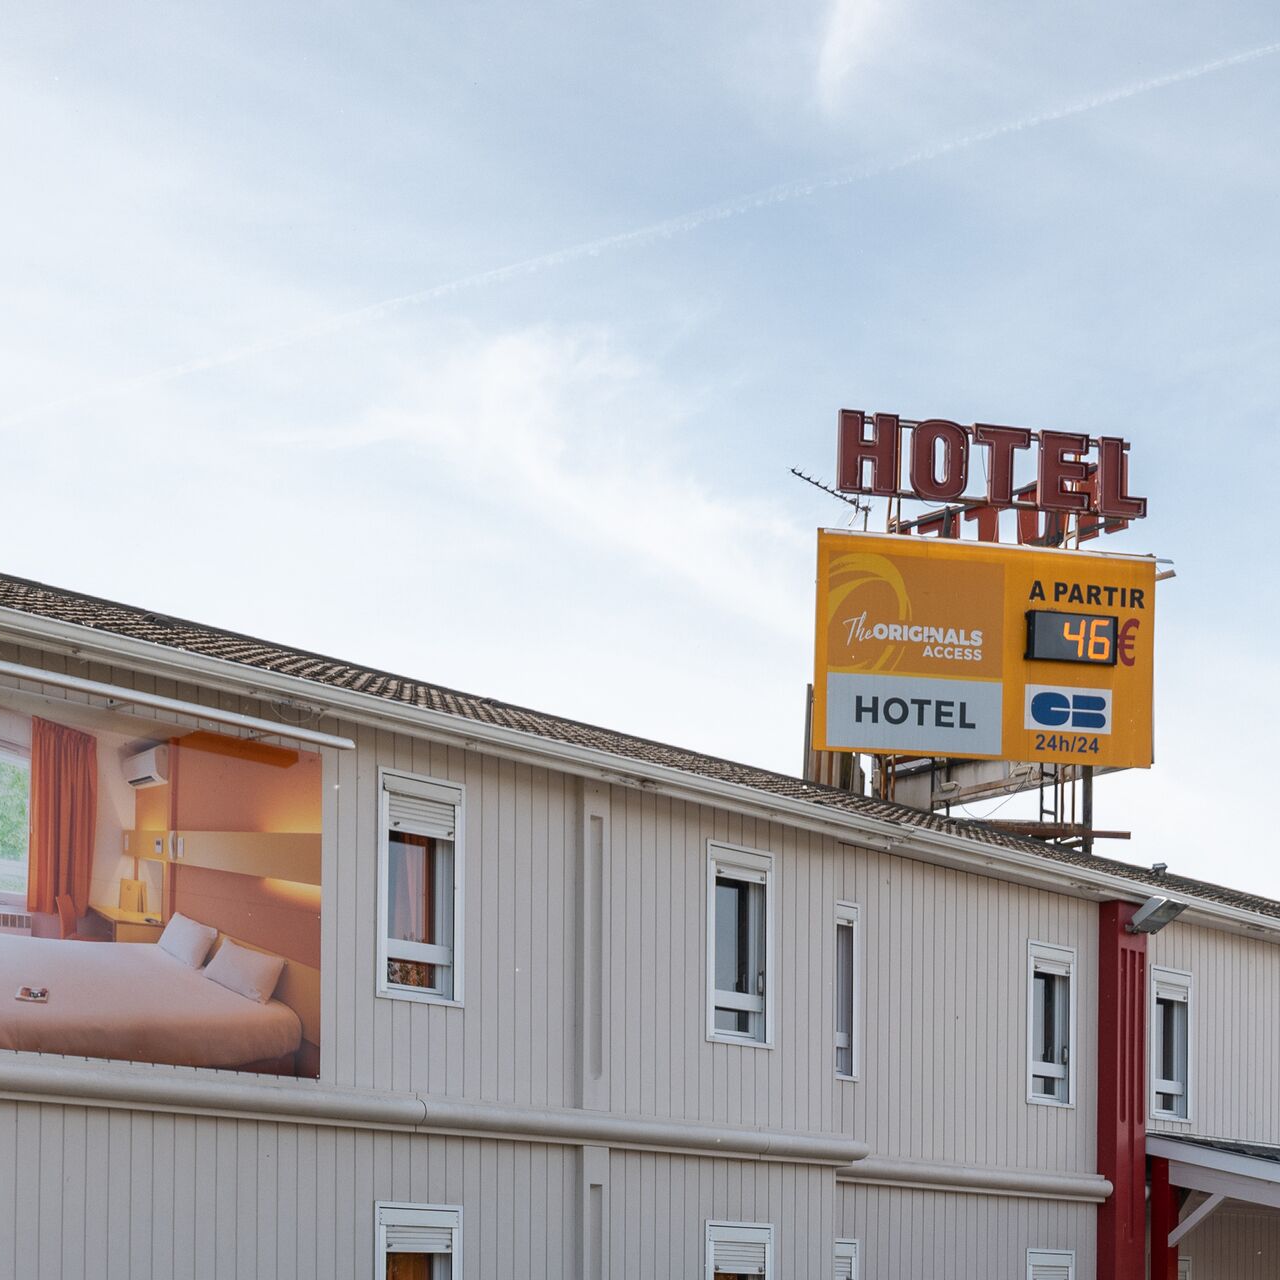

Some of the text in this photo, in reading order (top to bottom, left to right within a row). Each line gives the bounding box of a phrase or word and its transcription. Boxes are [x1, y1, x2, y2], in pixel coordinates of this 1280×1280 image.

[836, 408, 1147, 518] HOTEL
[1054, 581, 1145, 609] PARTIR
[922, 645, 983, 661] ACCESS
[1063, 618, 1111, 661] 46
[855, 695, 976, 729] HOTEL
[1035, 734, 1100, 753] 24h/24
